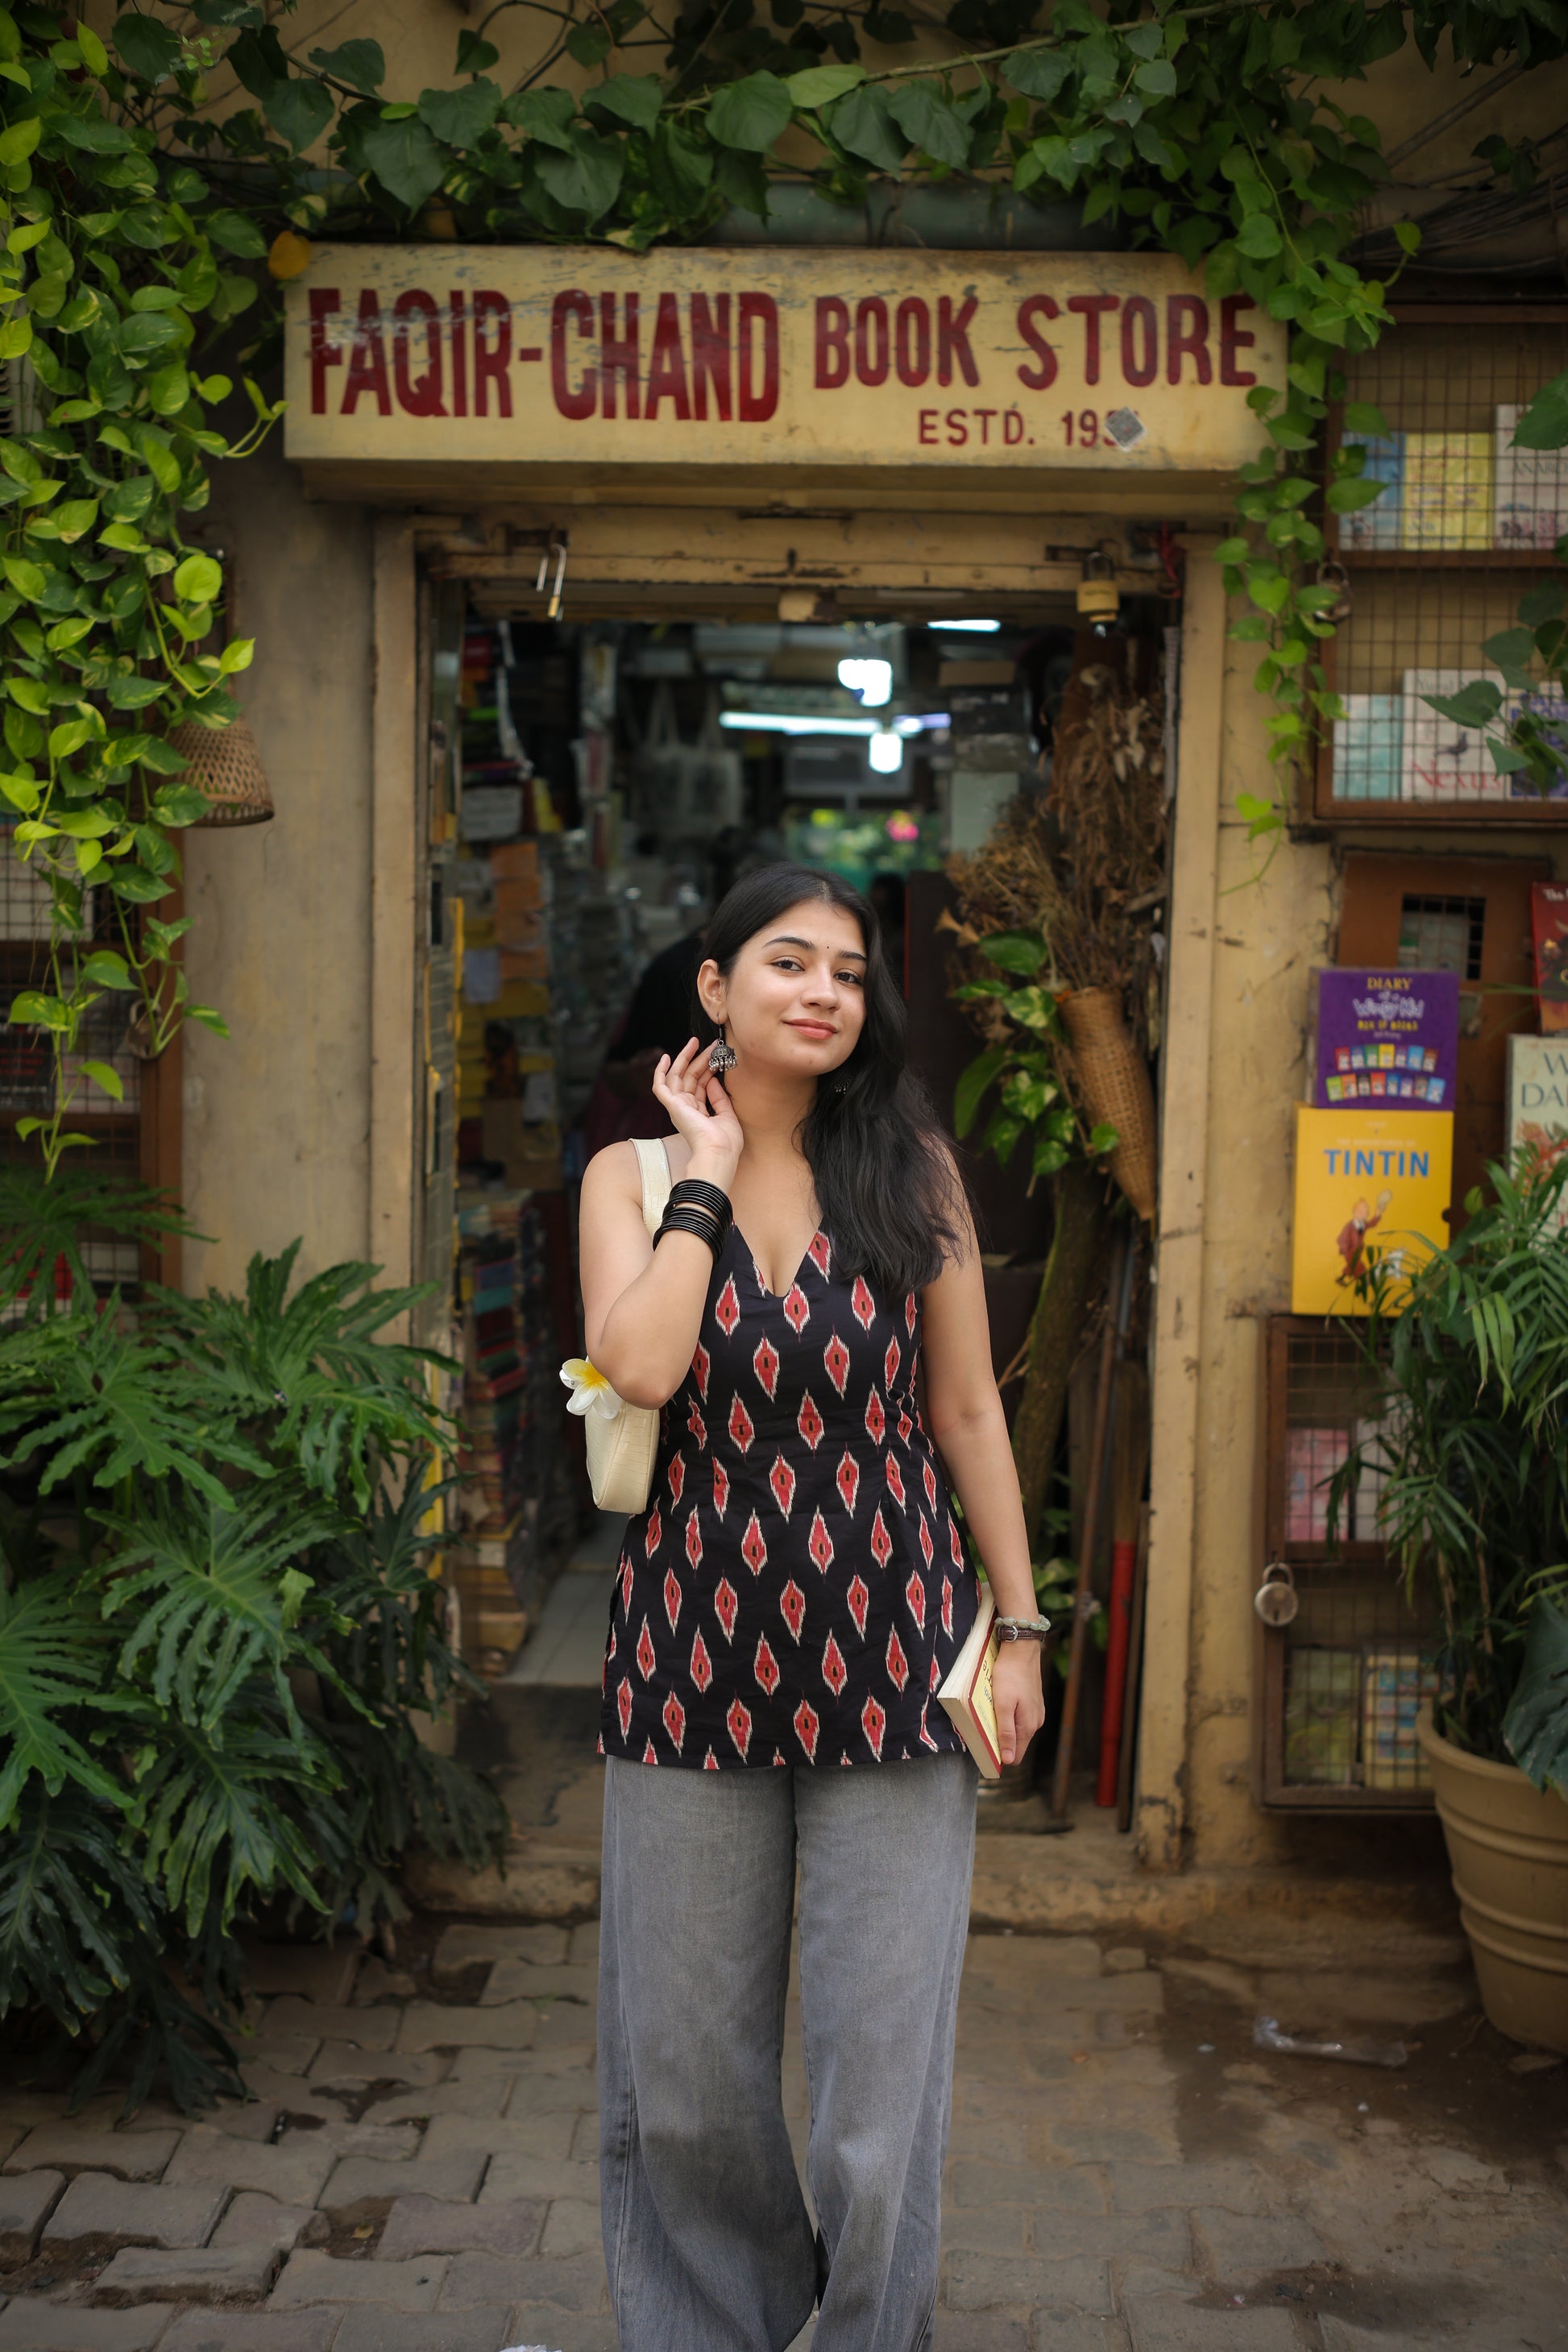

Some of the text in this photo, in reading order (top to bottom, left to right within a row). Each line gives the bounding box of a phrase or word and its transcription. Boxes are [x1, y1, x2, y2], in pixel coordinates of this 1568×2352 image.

[308, 288, 1258, 423] FAQIR-CHAND BOOK STORE
[919, 408, 1139, 448] ESTD. 19
[1412, 759, 1504, 790] Nexus
[1367, 976, 1412, 991] DIARY
[1520, 1082, 1568, 1109] DA
[1323, 1148, 1429, 1177] TINTIN
